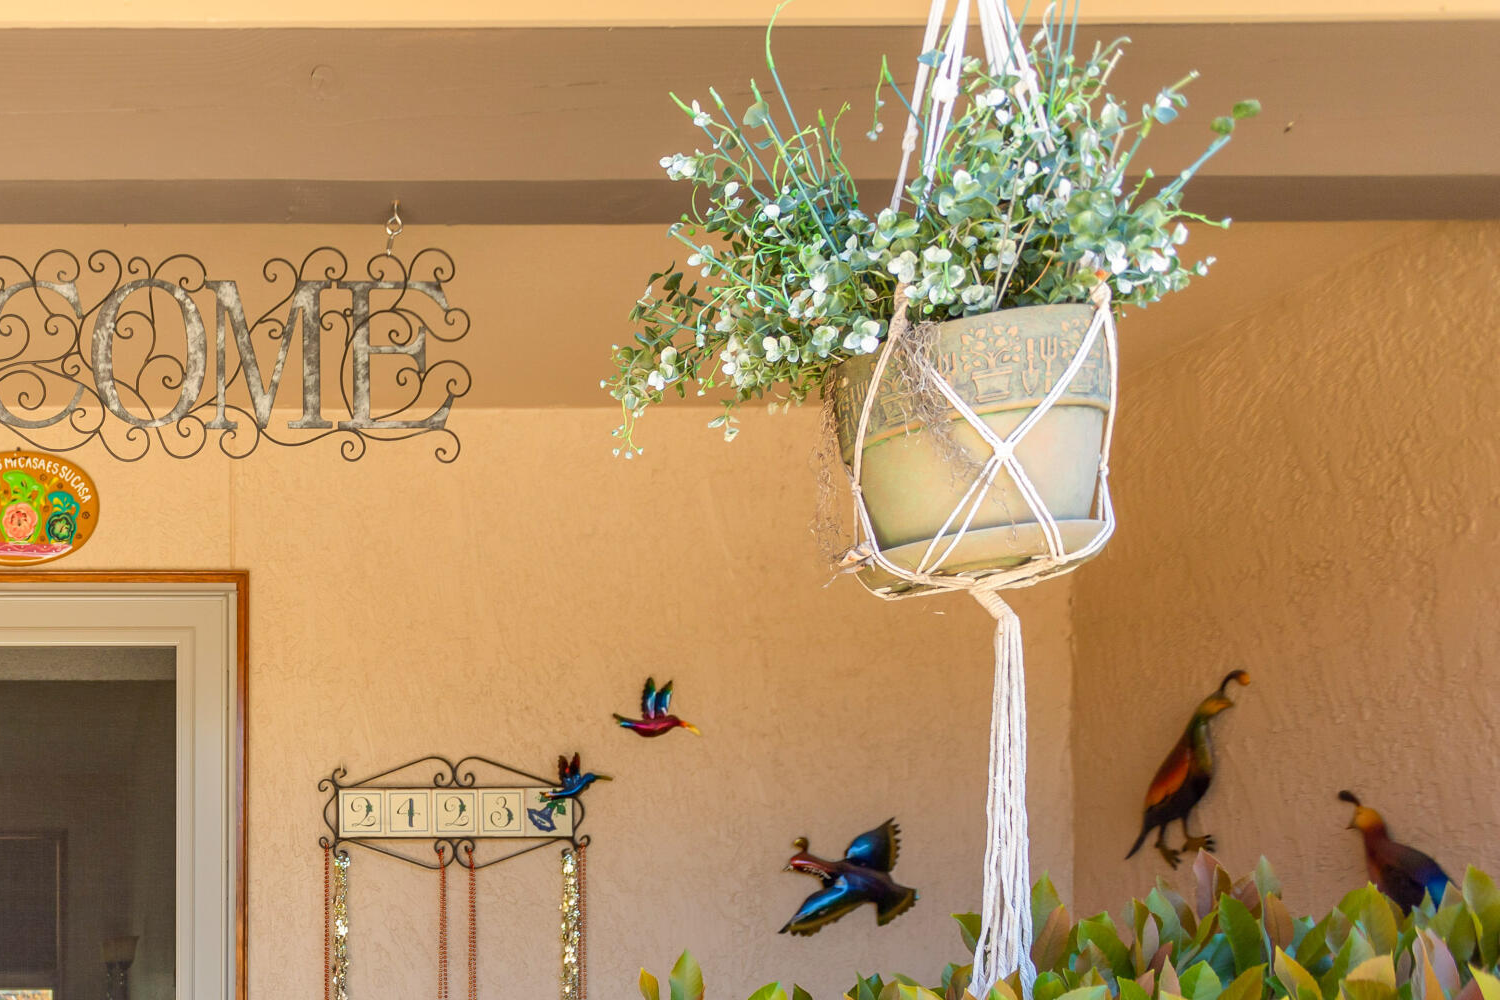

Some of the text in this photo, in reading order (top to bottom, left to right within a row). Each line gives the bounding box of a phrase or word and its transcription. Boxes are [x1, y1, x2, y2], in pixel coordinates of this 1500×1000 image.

[46, 461, 60, 475] ES
[59, 465, 75, 482] SU
[70, 475, 92, 503] CASA
[350, 796, 514, 828] 2423
